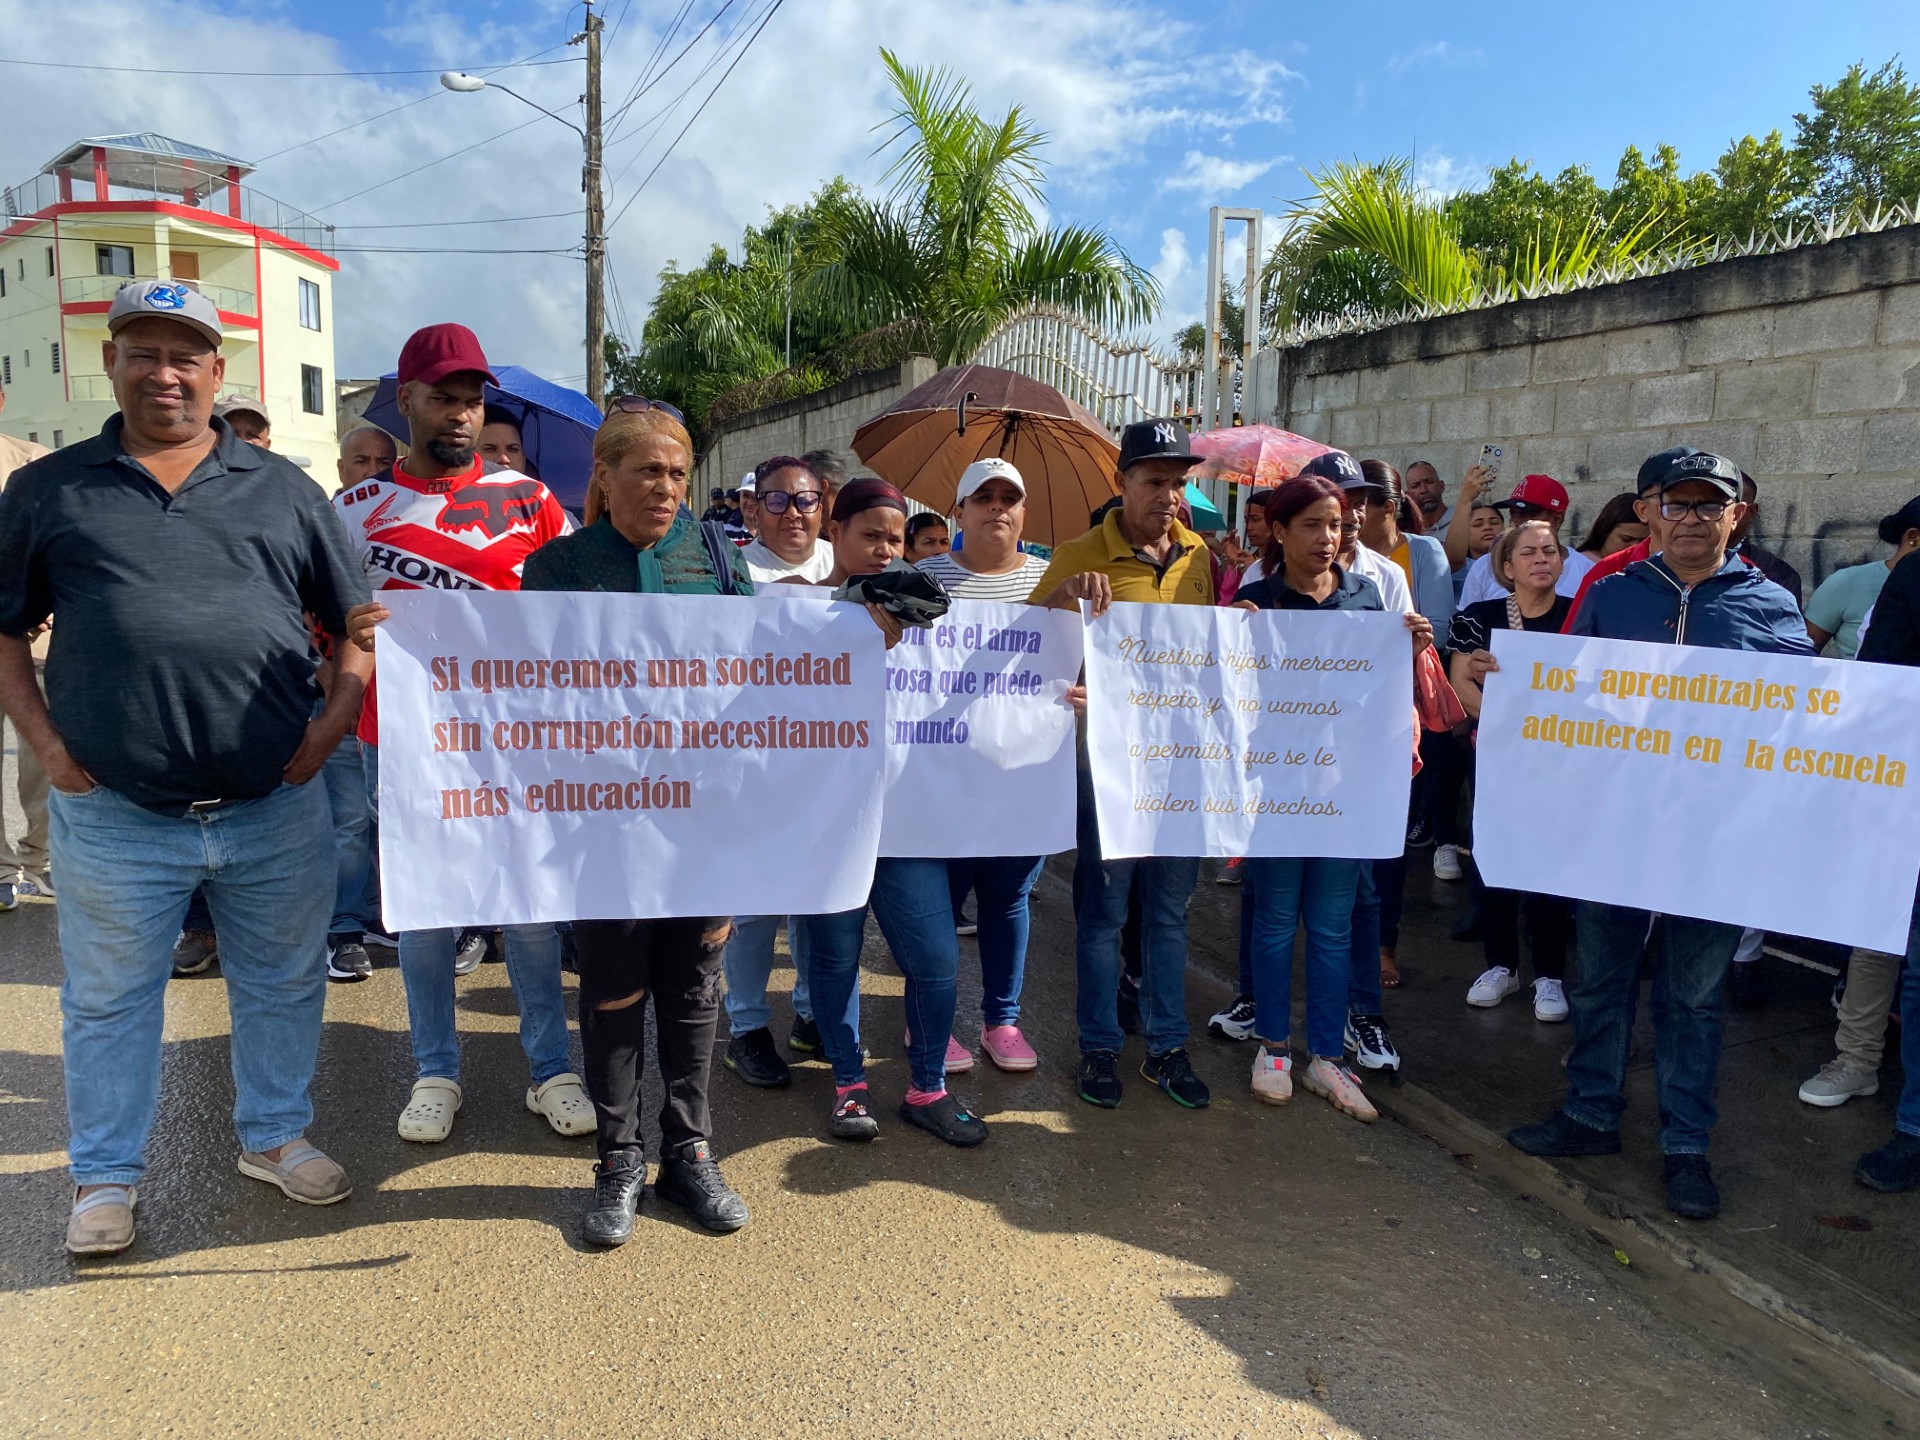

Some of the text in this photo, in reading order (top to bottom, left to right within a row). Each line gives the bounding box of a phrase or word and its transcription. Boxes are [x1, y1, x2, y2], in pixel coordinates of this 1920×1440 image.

[368, 546, 488, 591] HON
[936, 624, 957, 649] es
[963, 623, 982, 650] el
[988, 628, 1042, 654] arma
[1118, 636, 1373, 675] Nuestros hijos merecen
[431, 652, 852, 693] Si queremos una sociedad
[886, 667, 1043, 698] rosa que puede
[1530, 662, 1841, 716] Los aprendizajes se
[1127, 689, 1342, 718] respeto y no vamos
[433, 713, 869, 755] sin corrupción necesitamos
[895, 718, 969, 744] mundo
[1522, 713, 1907, 788] adquieren en la escuela
[1129, 742, 1336, 771] a permitir que se le
[440, 775, 691, 819] más educación
[1134, 792, 1343, 816] violen sus derechos.
